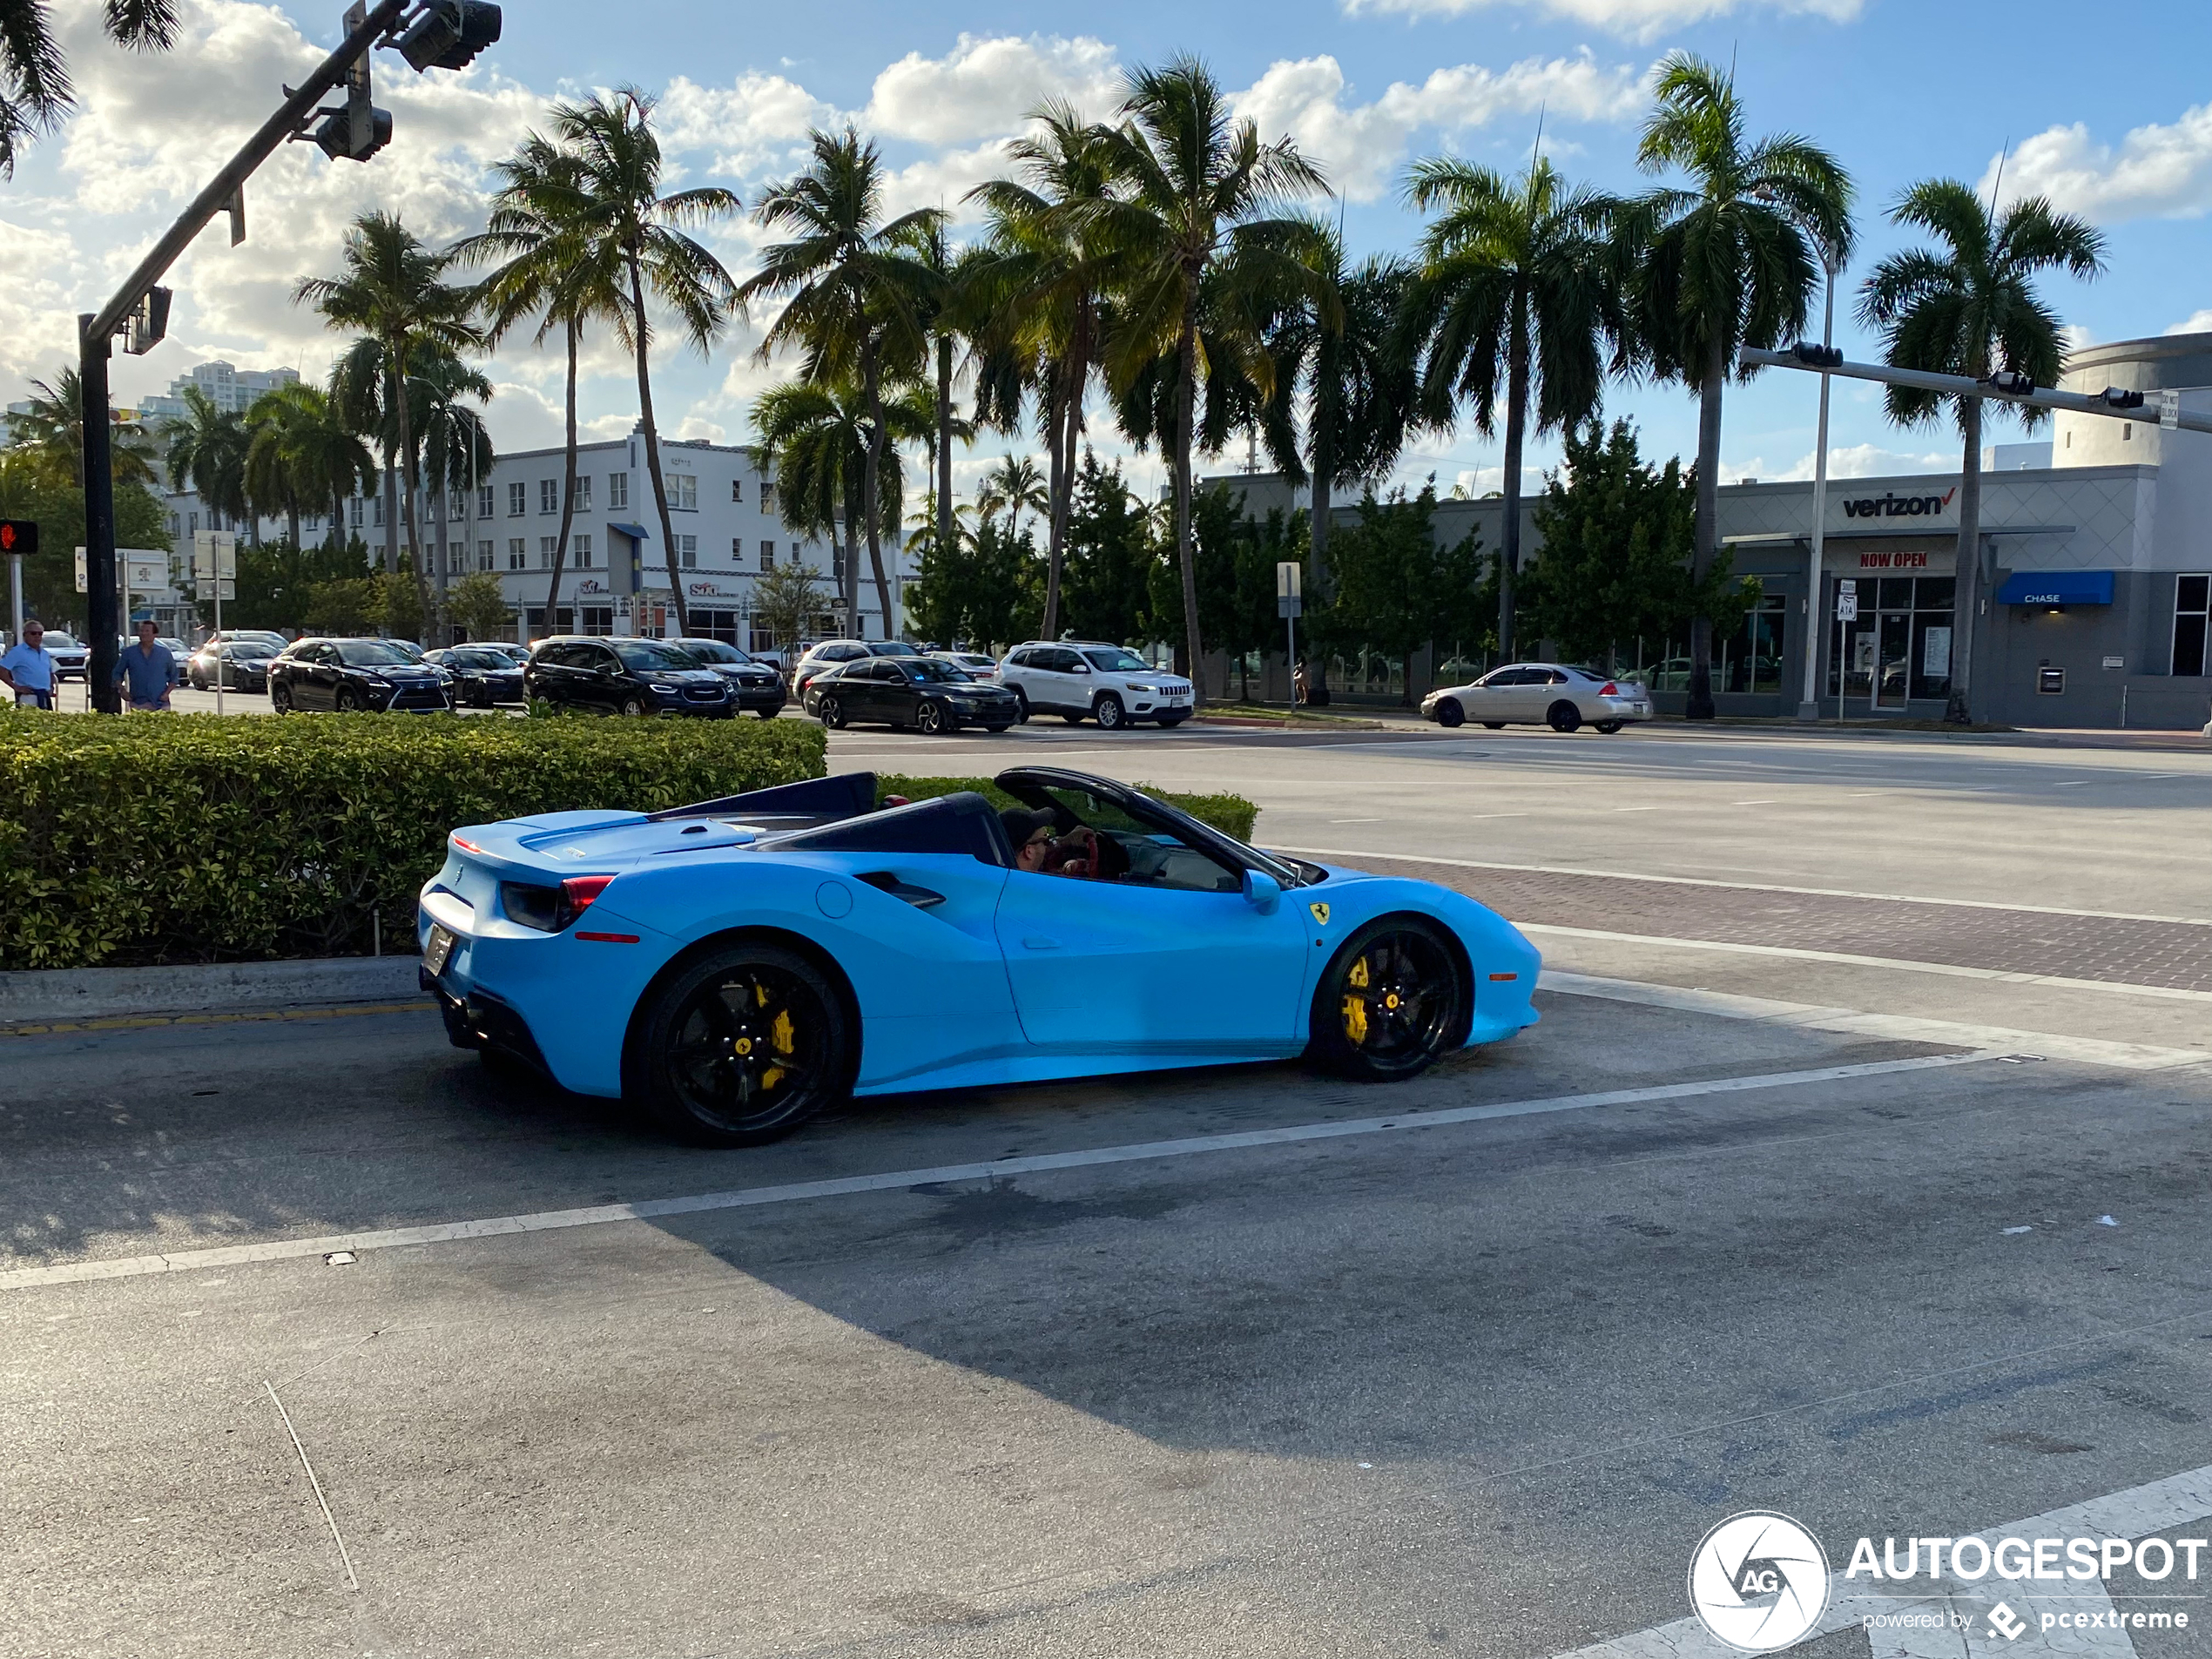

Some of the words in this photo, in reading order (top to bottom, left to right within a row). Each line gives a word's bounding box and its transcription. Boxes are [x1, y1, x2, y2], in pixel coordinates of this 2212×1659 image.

[2161, 395, 2169, 404] DO
[2169, 395, 2179, 406] NOT
[2161, 408, 2178, 418] BLOCK
[1844, 493, 1941, 517] verizon
[1860, 553, 1892, 568] NOW
[1893, 552, 1926, 568] OPEN
[2025, 594, 2060, 603] CHASE
